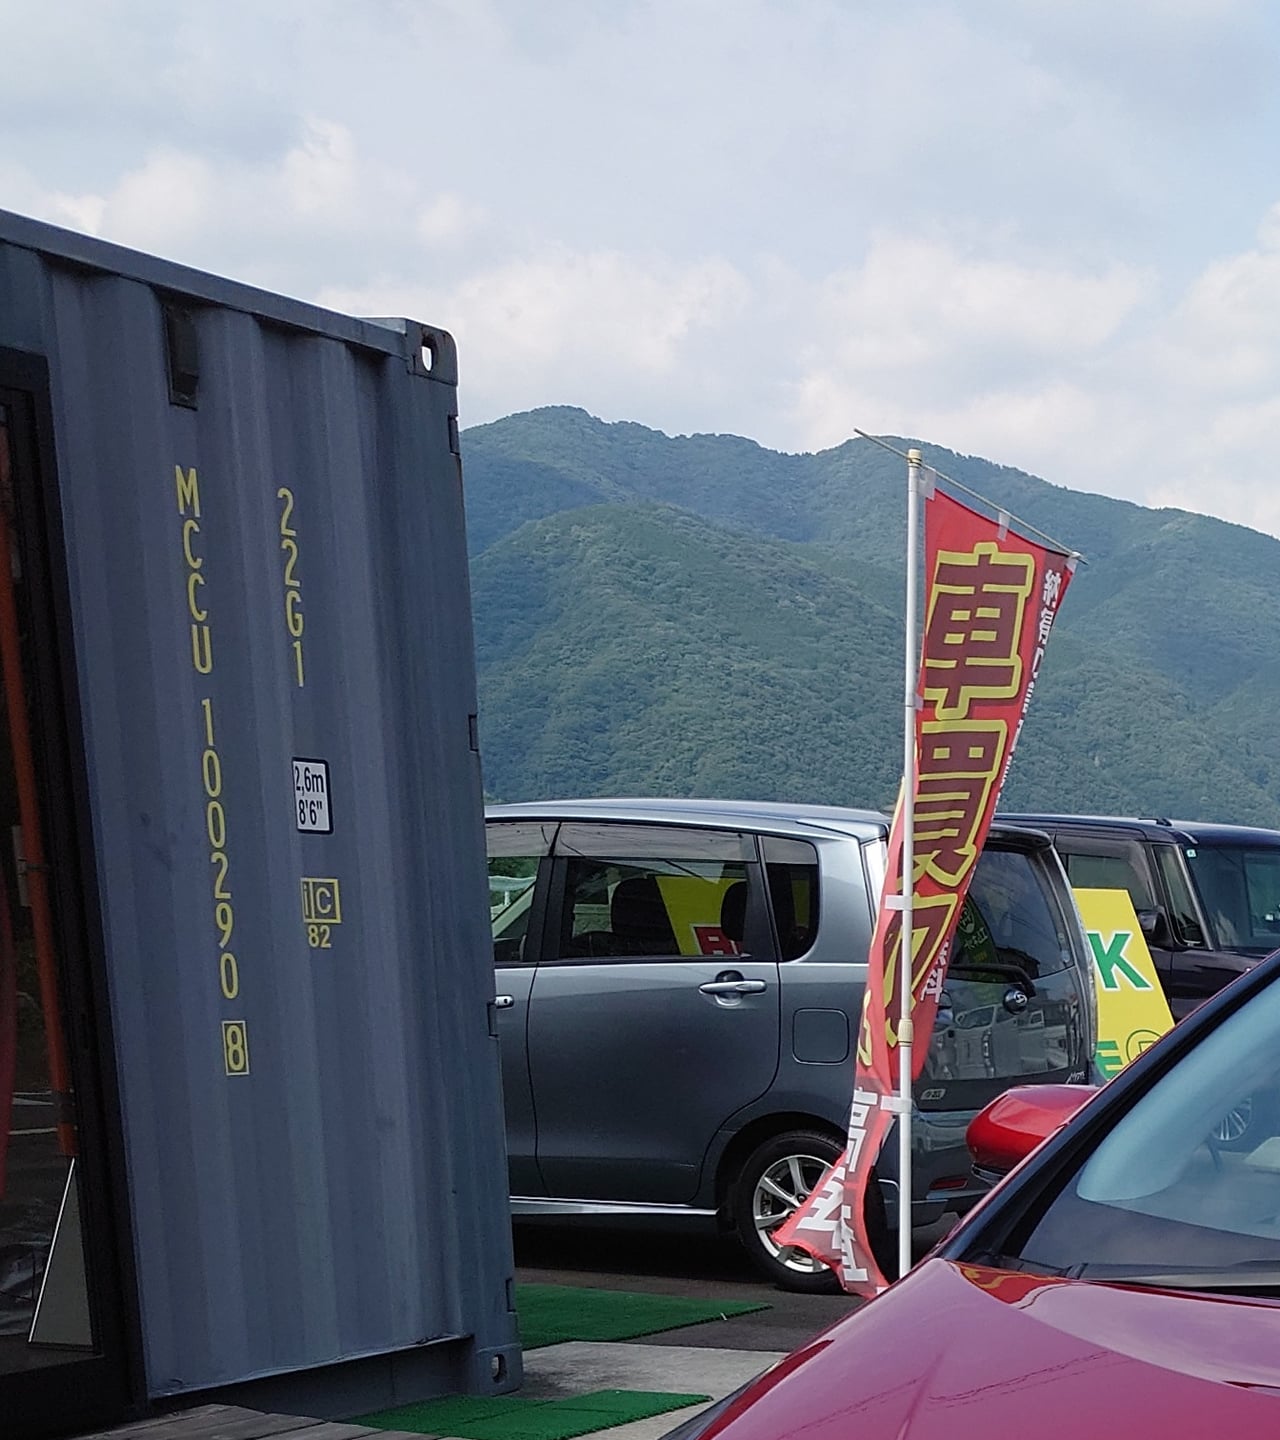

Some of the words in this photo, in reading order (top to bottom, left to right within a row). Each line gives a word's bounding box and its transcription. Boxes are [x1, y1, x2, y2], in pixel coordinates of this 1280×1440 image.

[277, 487, 305, 688] 22G1
[175, 465, 212, 674] MCCU
[201, 698, 240, 1000] 100290
[307, 924, 332, 949] 82
